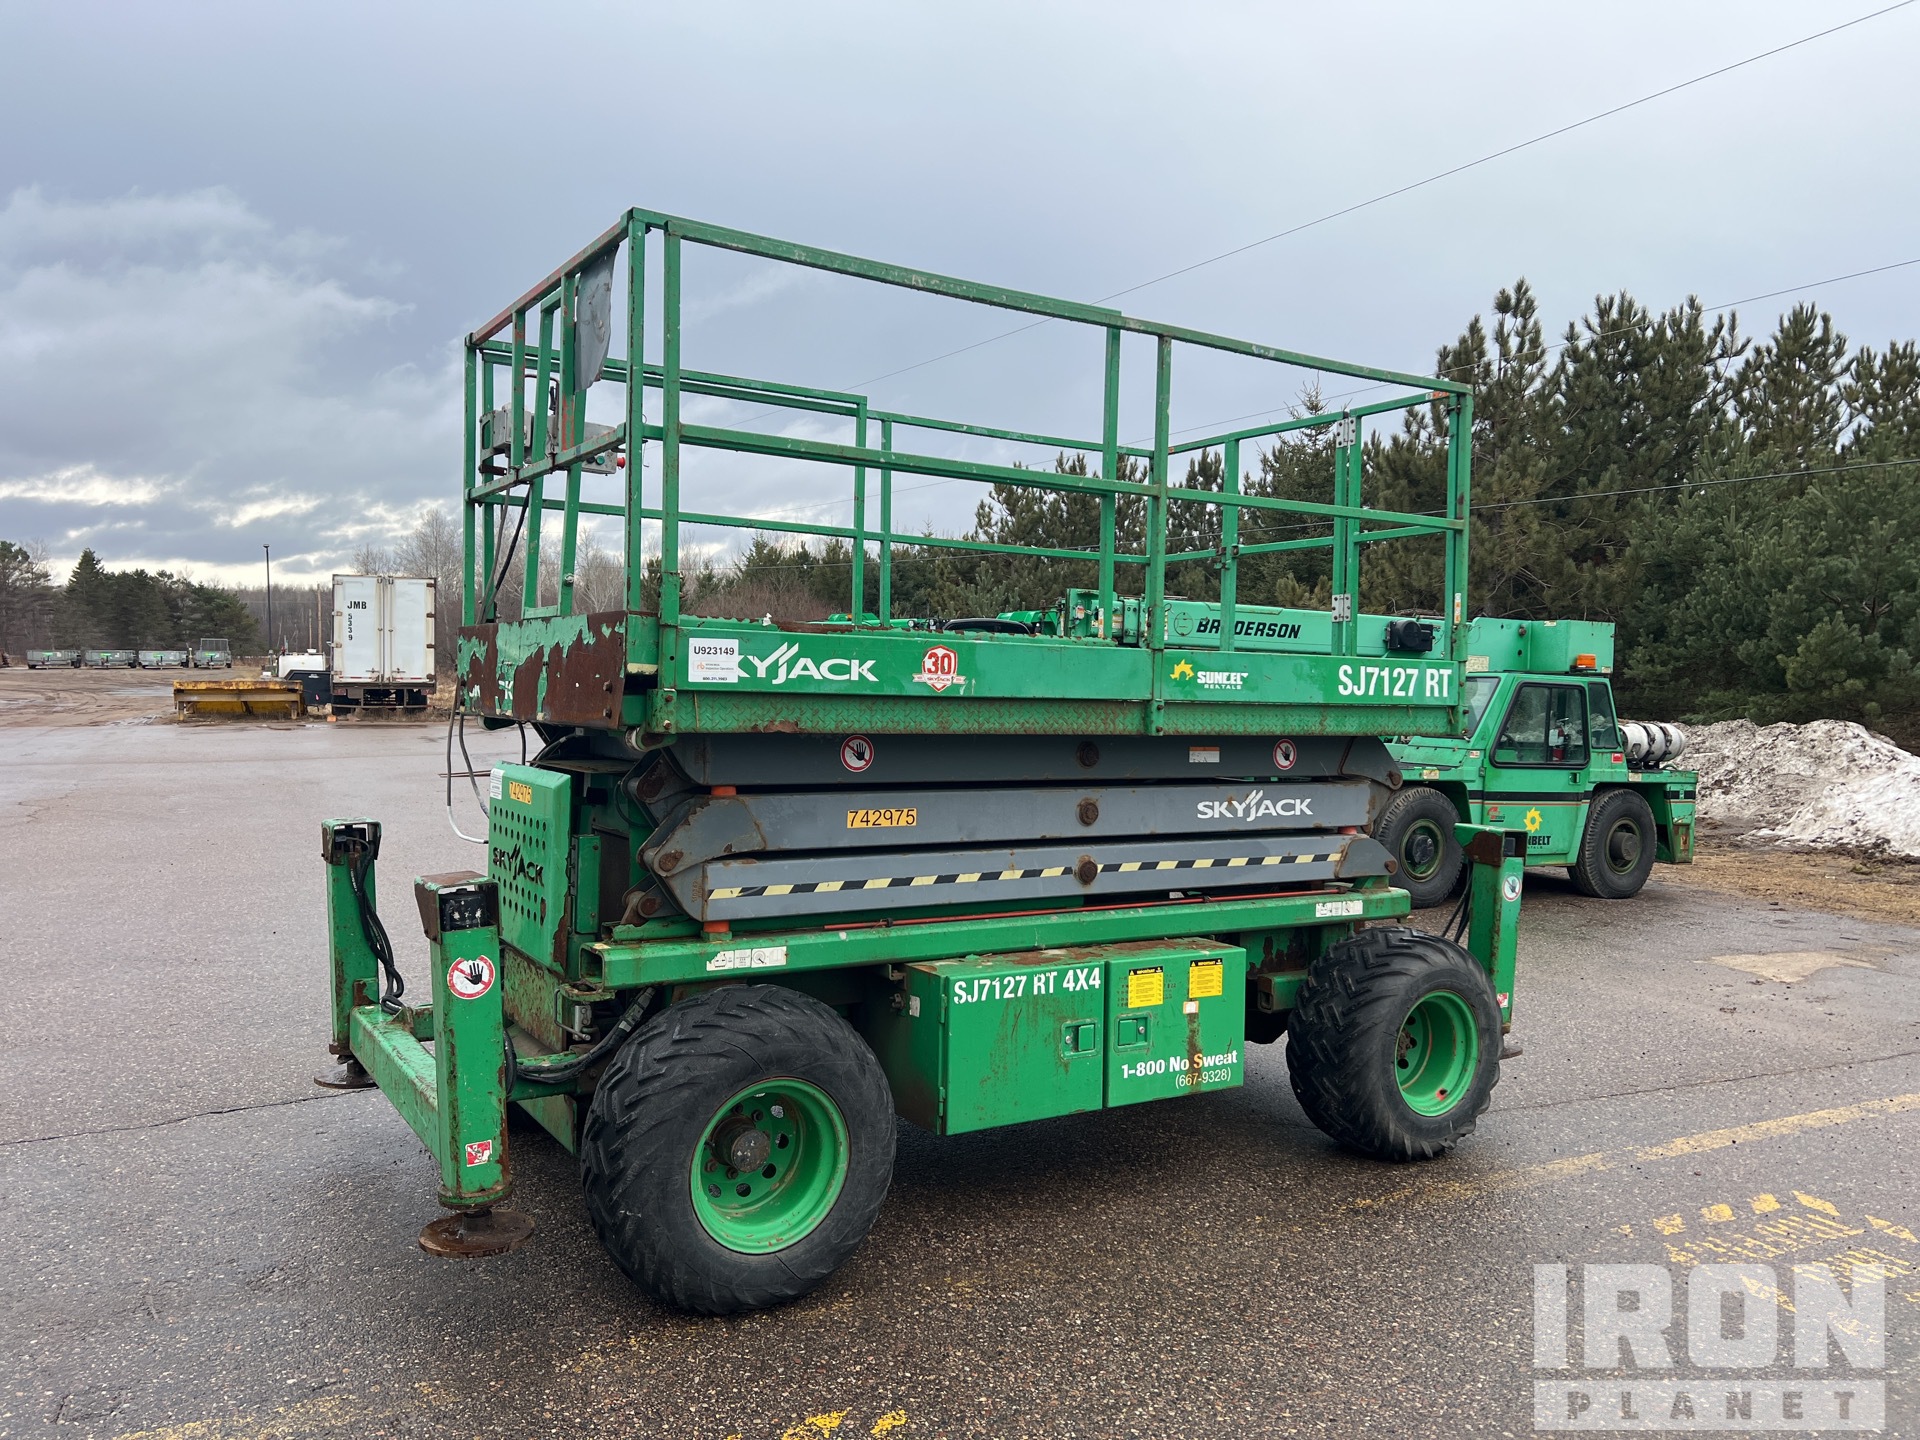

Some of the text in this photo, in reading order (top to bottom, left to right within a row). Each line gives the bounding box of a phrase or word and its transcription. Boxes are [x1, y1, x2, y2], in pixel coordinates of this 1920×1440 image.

[347, 601, 367, 609] JMB
[1196, 619, 1301, 639] BRDERSON
[694, 646, 735, 655] U923149
[738, 641, 879, 685] YJACK
[927, 652, 952, 674] 30
[1338, 665, 1452, 697] SJ7127 RT
[1197, 789, 1314, 821] SKYJACK
[849, 809, 915, 827] 742975
[1528, 836, 1551, 845] BELT
[493, 843, 544, 887] SKYJACK
[953, 975, 1026, 1004] SJ7127
[1033, 971, 1058, 996] RT
[1062, 967, 1101, 992] 4X4
[1121, 1050, 1238, 1079] 1-800 No Sweat
[1175, 1067, 1231, 1089] (667-9328)
